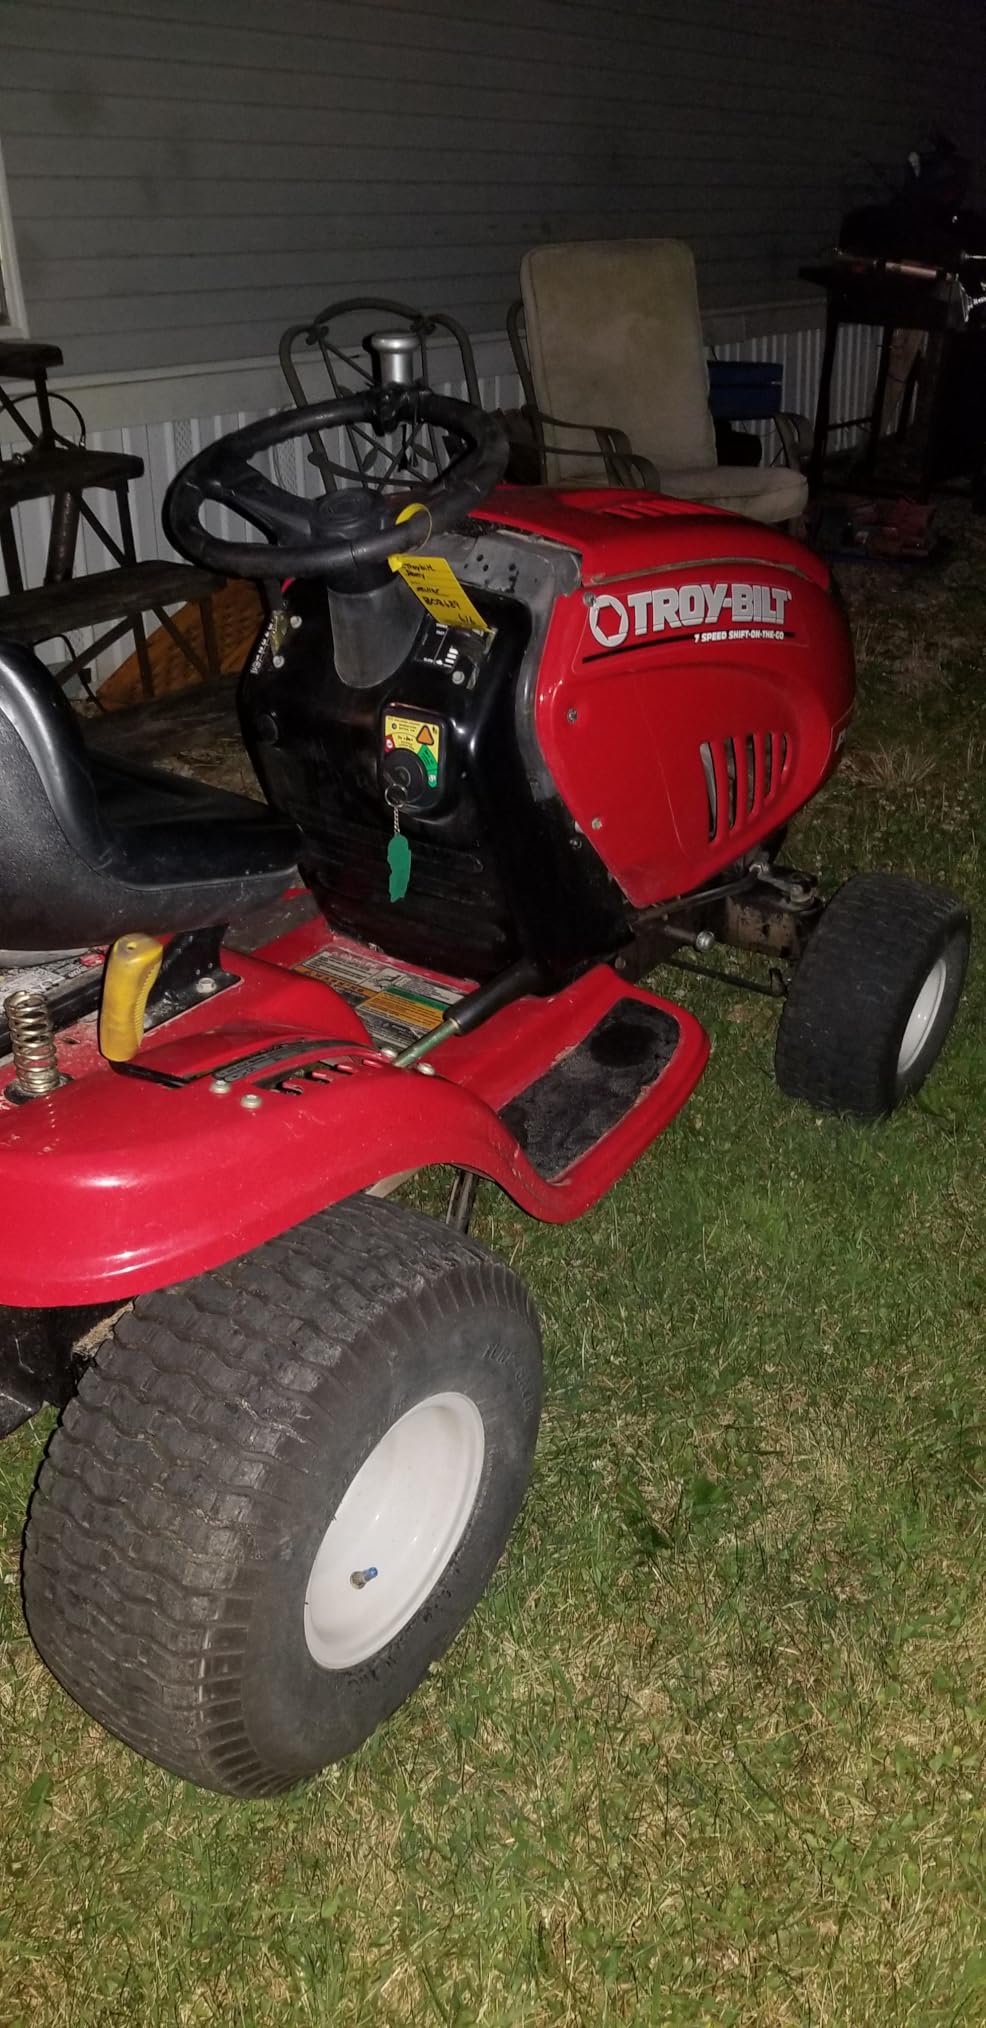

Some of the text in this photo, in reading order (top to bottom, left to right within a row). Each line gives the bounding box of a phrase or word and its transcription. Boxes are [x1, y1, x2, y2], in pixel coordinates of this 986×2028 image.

[628, 583, 787, 636] TROY-BILT
[694, 633, 700, 643] 7
[701, 630, 727, 642] SPEED
